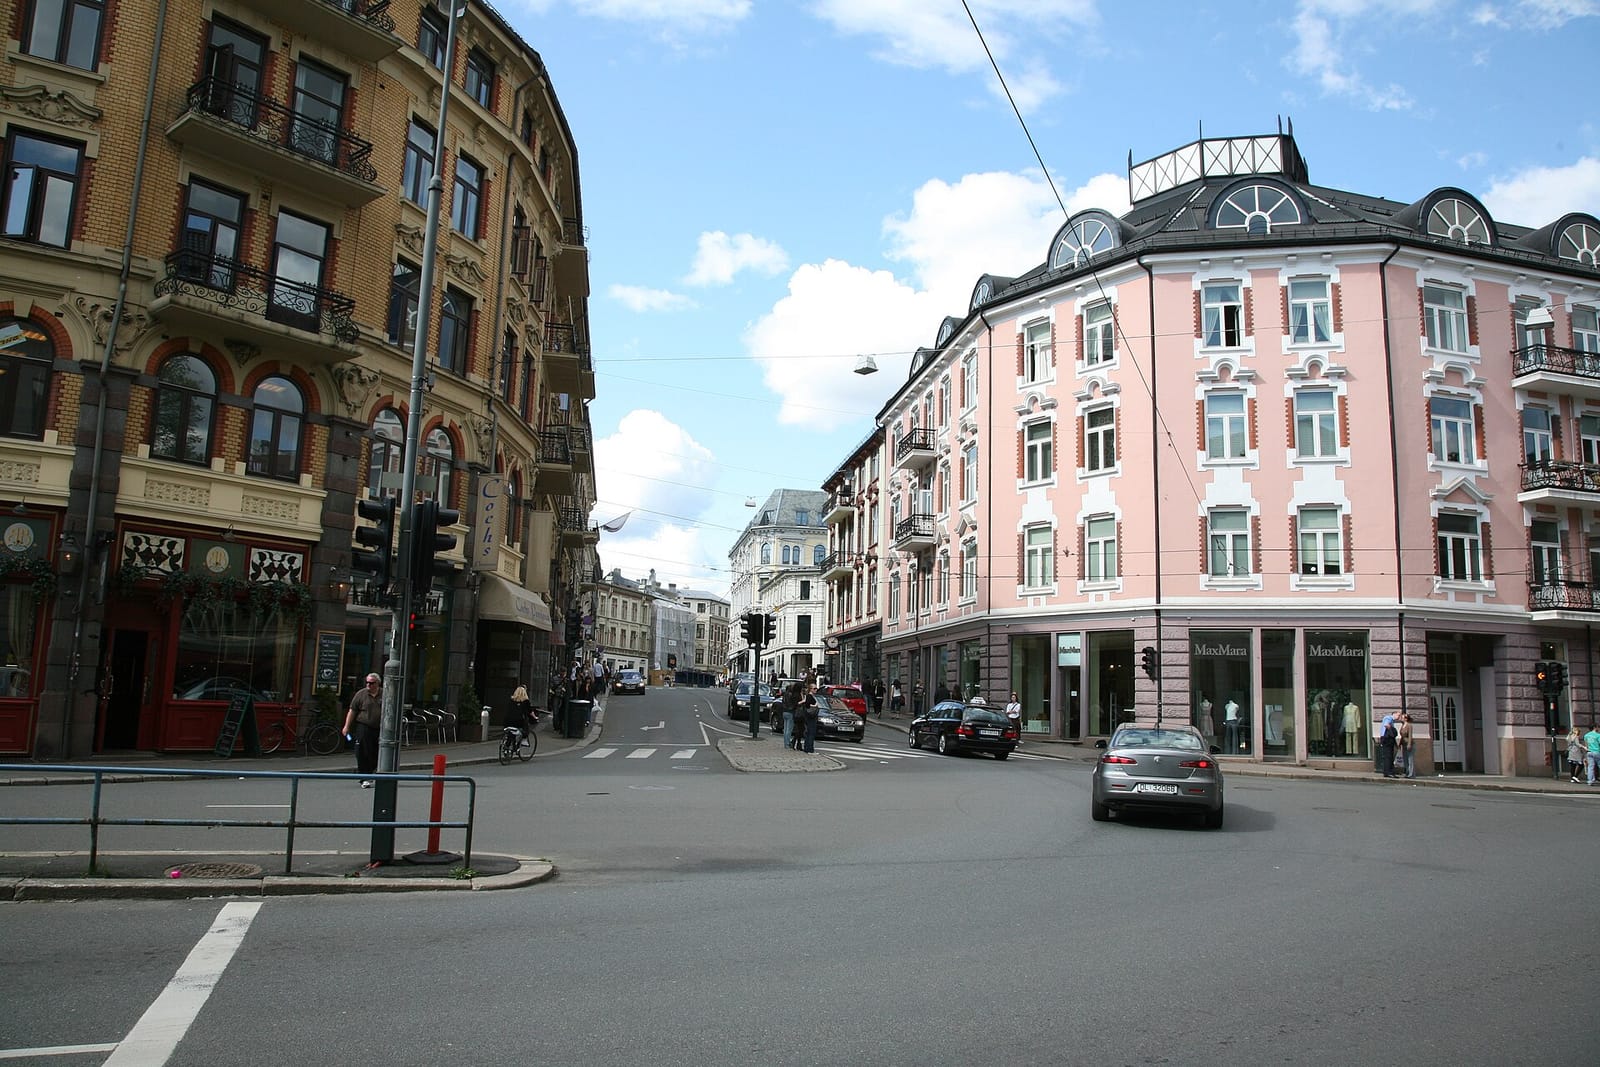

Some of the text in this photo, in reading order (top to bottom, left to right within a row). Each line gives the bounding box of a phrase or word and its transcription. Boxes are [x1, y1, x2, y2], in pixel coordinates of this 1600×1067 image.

[482, 479, 499, 556] Cochs
[1194, 643, 1247, 656] MaxMara
[1309, 644, 1364, 657] MaxMara
